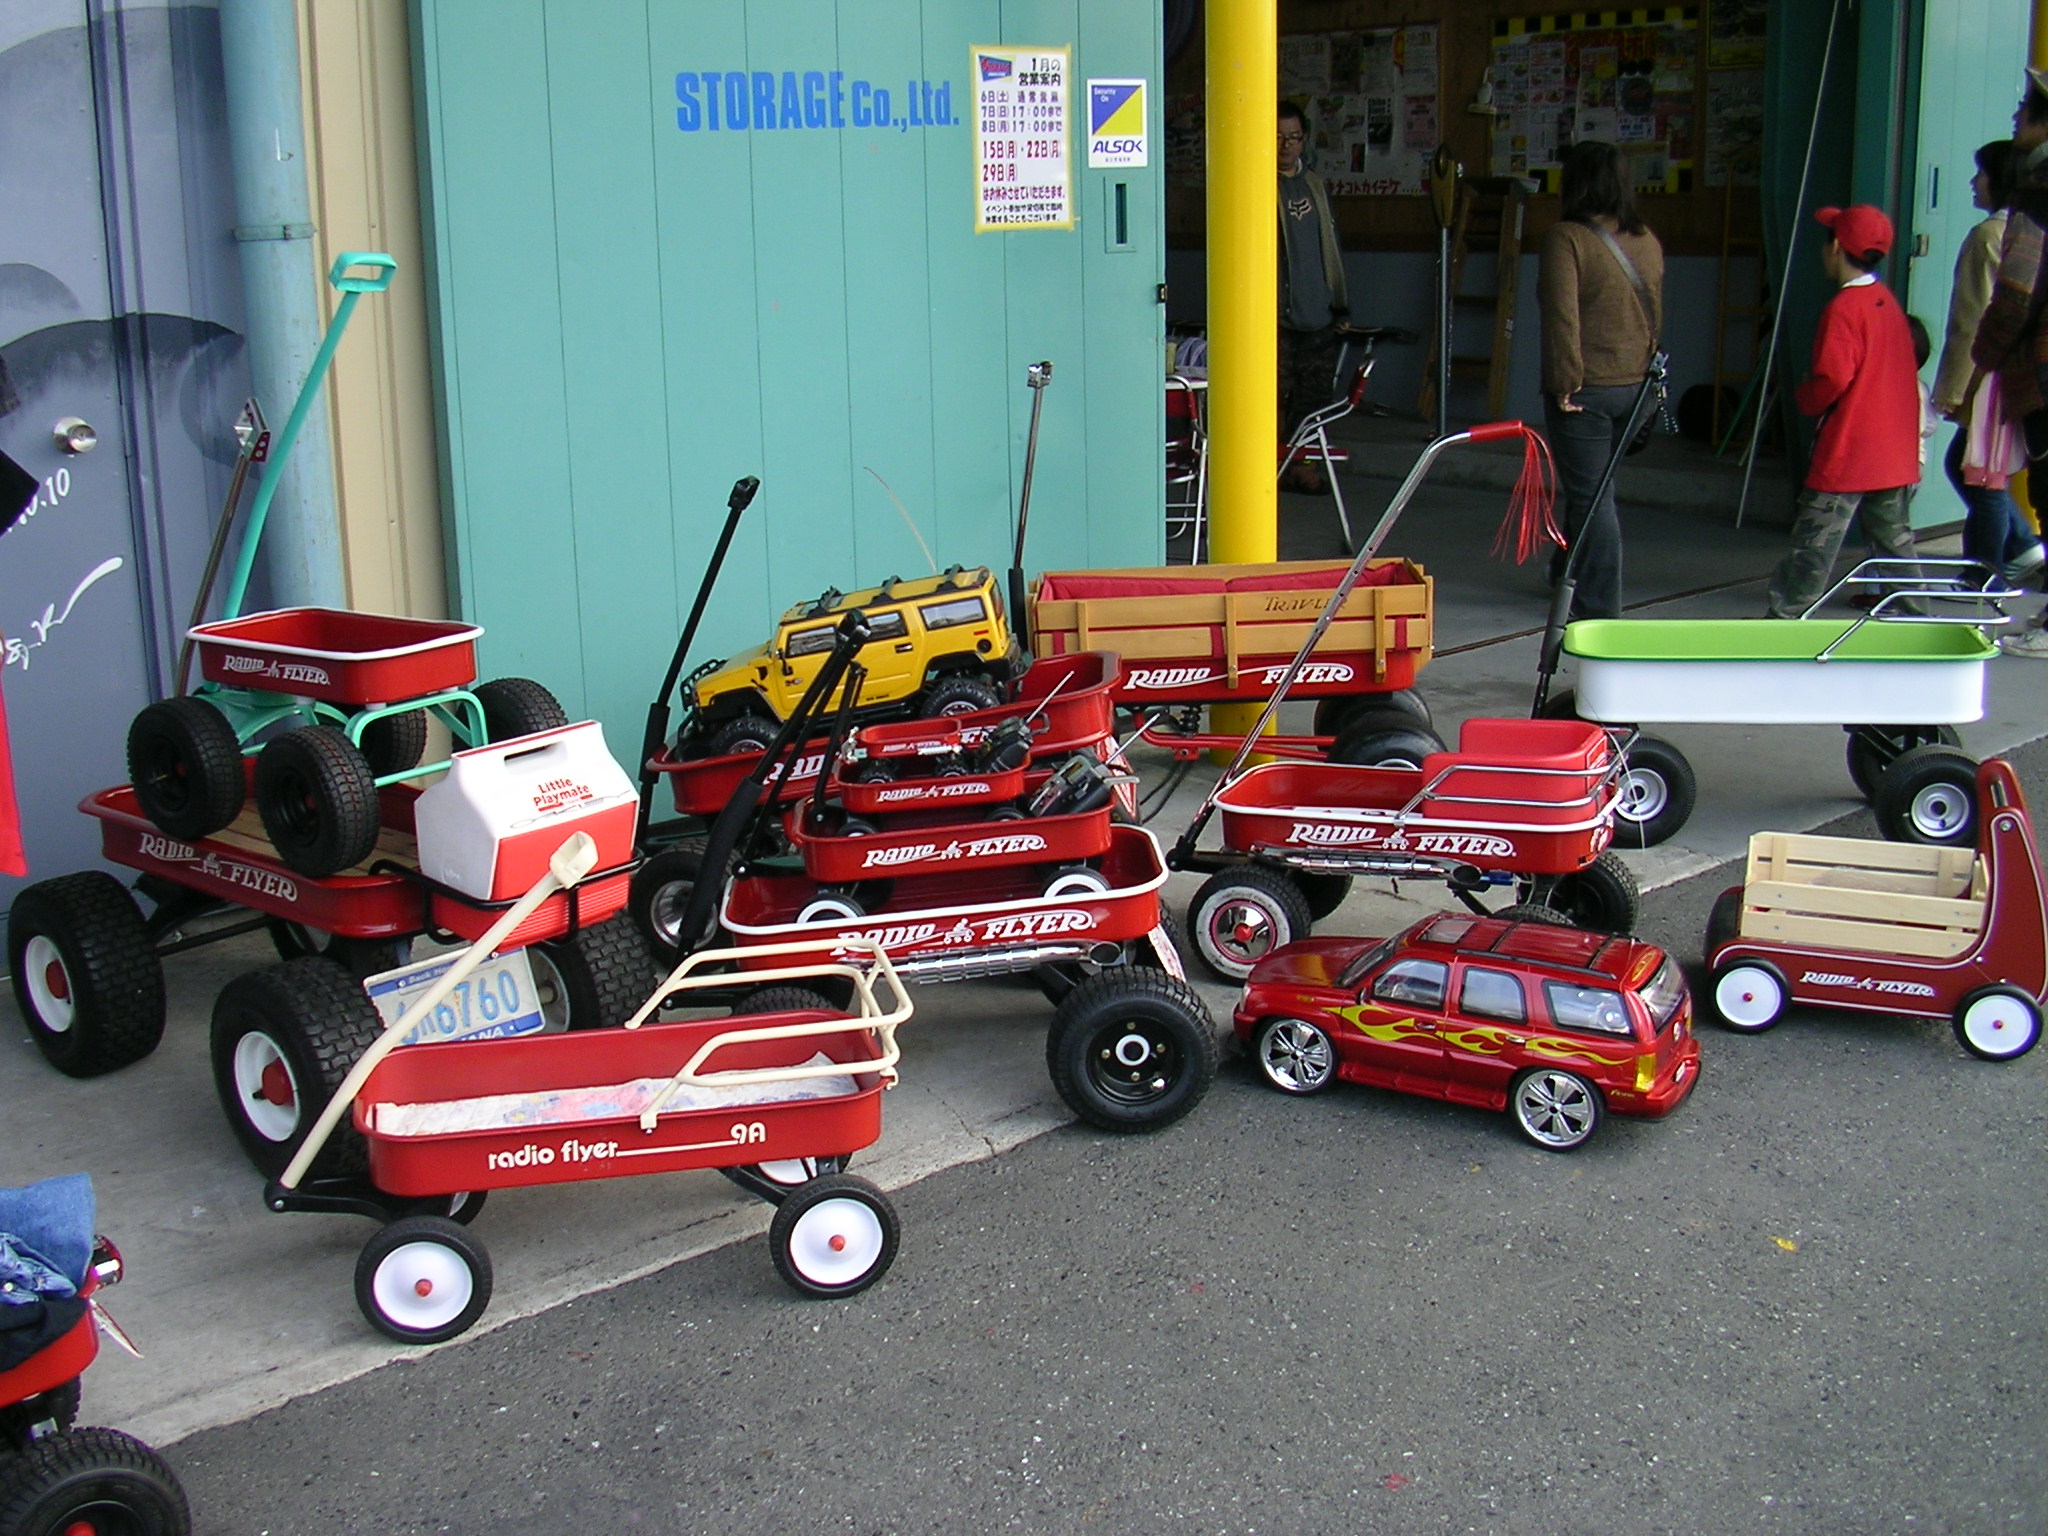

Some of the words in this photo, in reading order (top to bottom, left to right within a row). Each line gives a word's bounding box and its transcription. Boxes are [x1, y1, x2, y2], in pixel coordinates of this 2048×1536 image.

[1019, 72, 1061, 86] 営業案内
[675, 71, 845, 132] STORAGE
[852, 80, 960, 133] Co.,Ltd.
[1092, 140, 1142, 153] ALSOK
[222, 654, 265, 673] RADIO
[1124, 668, 1212, 690] RADIO
[533, 785, 589, 806] Playmate
[538, 779, 573, 793] Little
[876, 787, 924, 802] RADIO
[1286, 823, 1377, 845] RADIO
[861, 844, 937, 868] RADIO
[139, 832, 195, 861] RADIO
[229, 864, 298, 902] FLYER
[830, 923, 937, 956] RADIO
[1799, 971, 1856, 985] RADIO
[488, 1145, 555, 1170] radio
[560, 1139, 619, 1163] flyer
[730, 1122, 766, 1144] 9A
